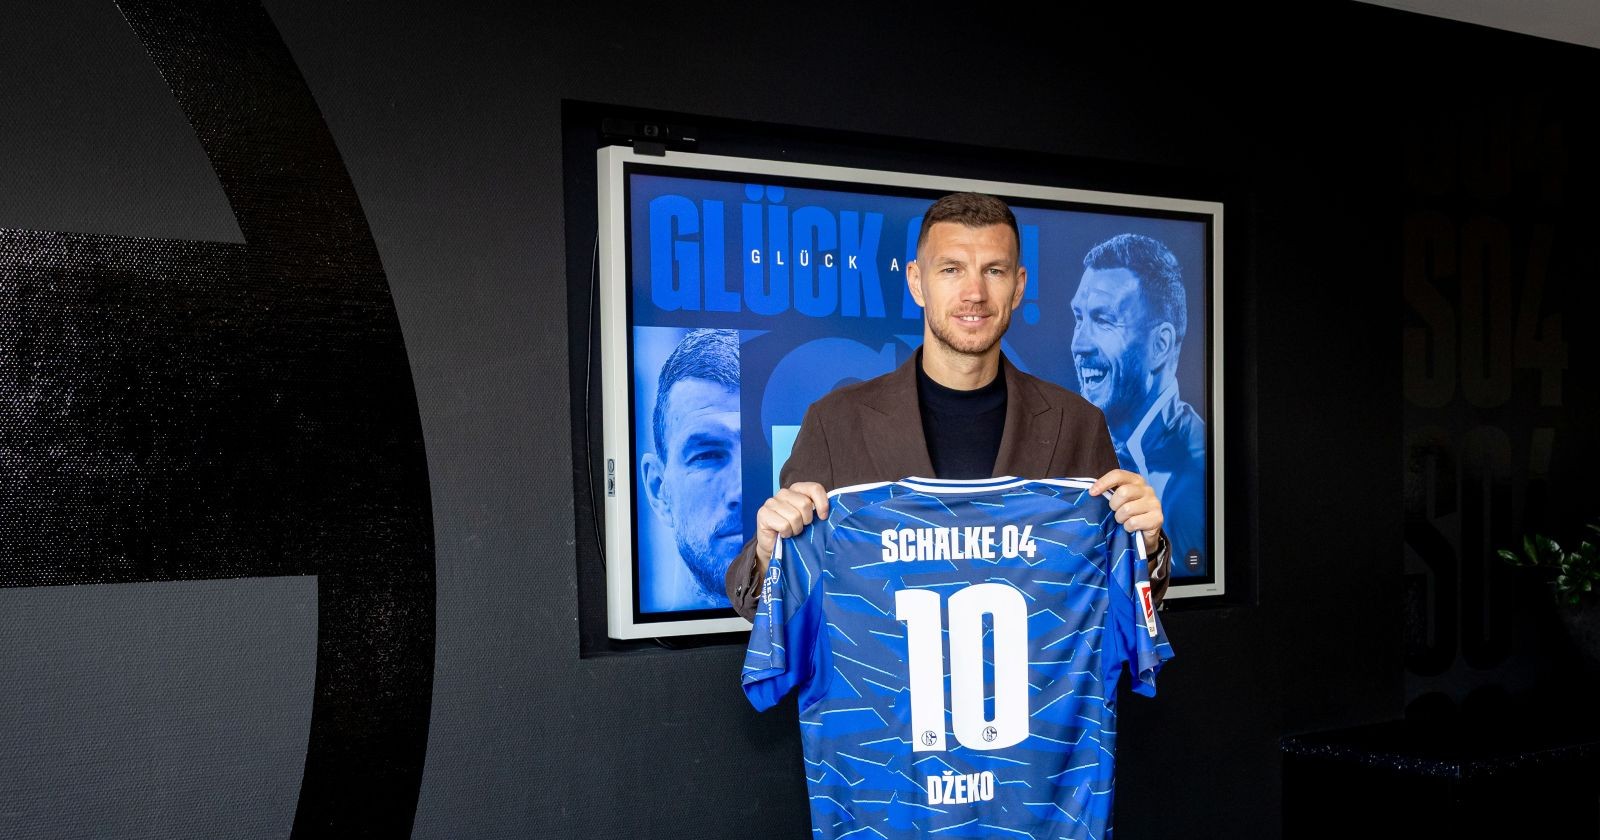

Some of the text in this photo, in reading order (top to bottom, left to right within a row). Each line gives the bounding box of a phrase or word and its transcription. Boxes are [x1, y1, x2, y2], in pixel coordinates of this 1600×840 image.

[650, 183, 886, 318] GLÜCK
[751, 250, 857, 270] GLÜCK
[881, 525, 1037, 562] SCHALKE 04
[895, 583, 1029, 752] 10
[927, 770, 994, 805] DŽEKO
